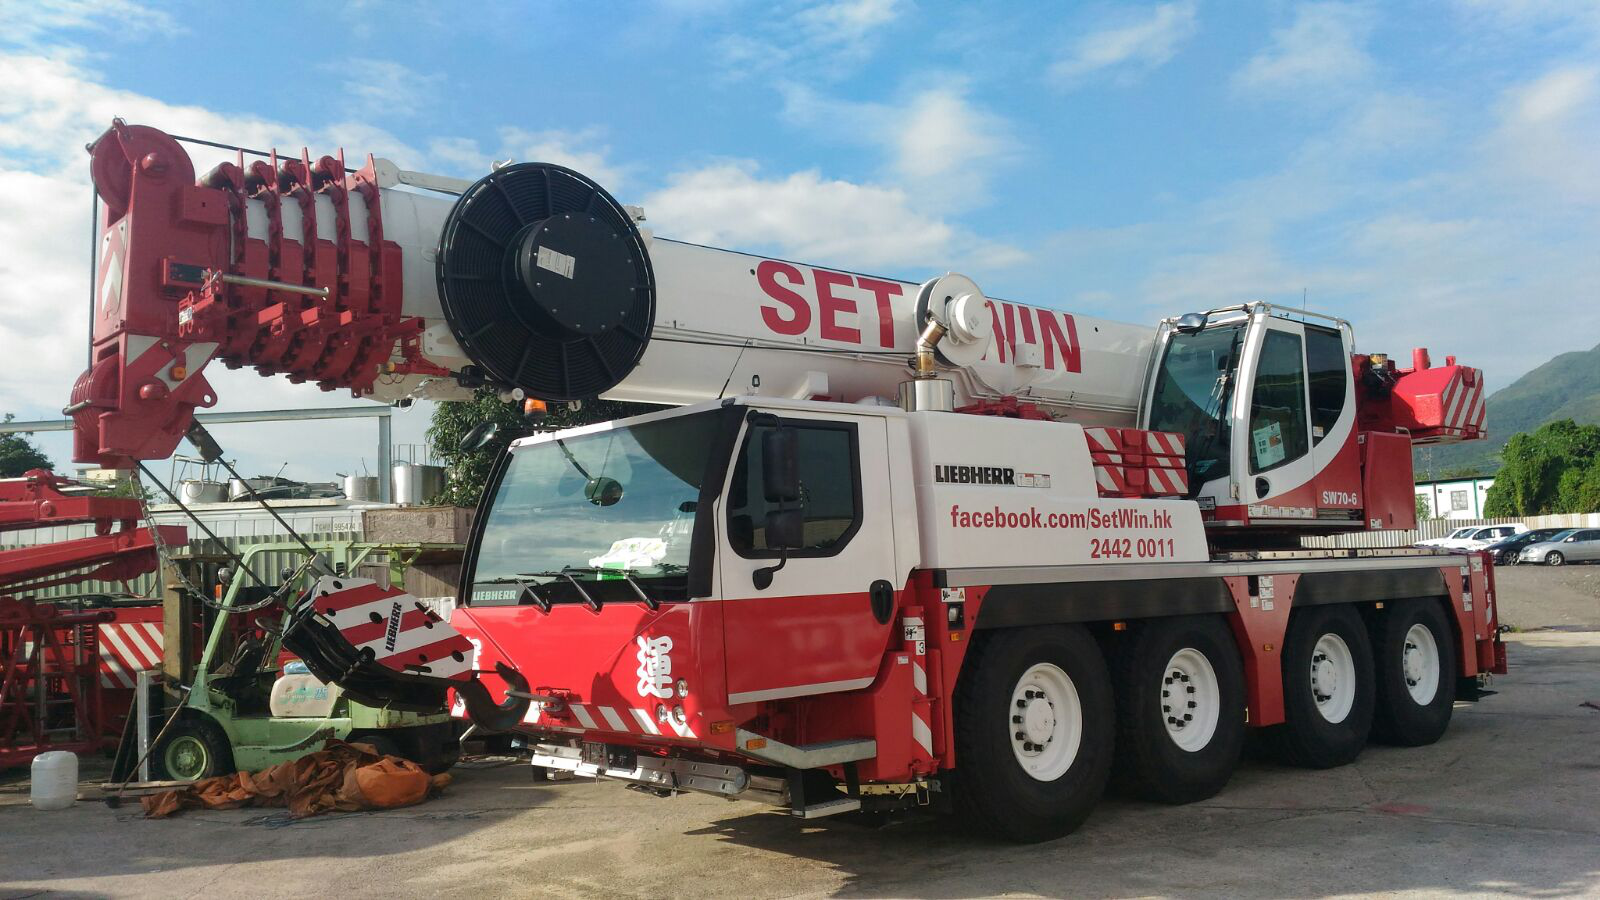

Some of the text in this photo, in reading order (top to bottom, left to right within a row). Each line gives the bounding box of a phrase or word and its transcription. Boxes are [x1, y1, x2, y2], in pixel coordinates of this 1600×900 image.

[756, 260, 904, 349] SET
[935, 465, 1015, 485] LIEBHERR
[1322, 491, 1358, 506] SW70-6
[950, 504, 1173, 530] facebook.com/SetWin.hk
[1090, 538, 1175, 559] 2442 0011
[472, 589, 517, 601] LIEBHERR
[384, 602, 402, 652] LIEBHERR
[918, 641, 925, 654] 3
